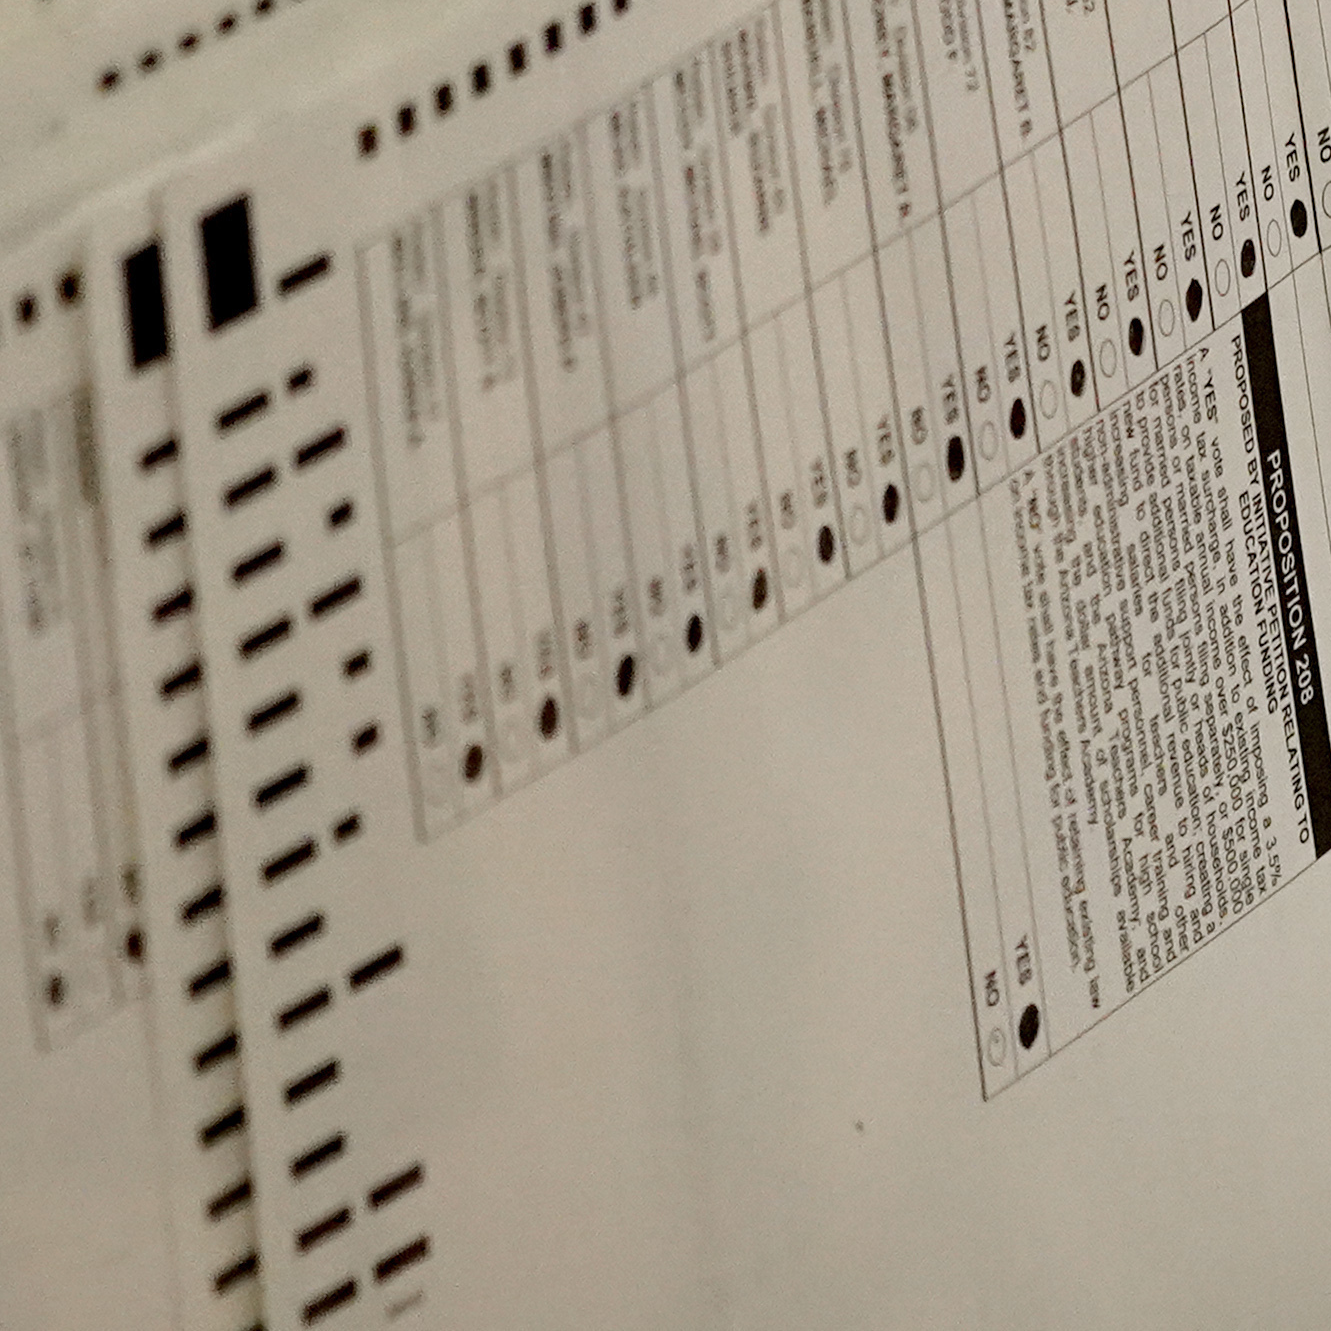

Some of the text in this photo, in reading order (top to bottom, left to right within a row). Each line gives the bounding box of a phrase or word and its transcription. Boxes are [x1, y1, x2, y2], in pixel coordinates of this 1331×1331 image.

[1284, 132, 1301, 183] YES
[1261, 164, 1275, 202] NO
[1198, 347, 1210, 362] A
[1210, 436, 1224, 479] vote
[1217, 486, 1233, 532] shall
[1224, 537, 1239, 587] have
[1266, 448, 1314, 706] PROPOSITION 208
[1231, 334, 1310, 844] PROPOSED BY INITIATIVE PETITION RELATING TO
[1232, 593, 1244, 627] the
[1238, 489, 1279, 715] EDUCATION FUNDING
[1237, 634, 1254, 688] effect
[1246, 695, 1259, 715] of
[1244, 720, 1269, 809] imposing
[1262, 816, 1272, 830] a
